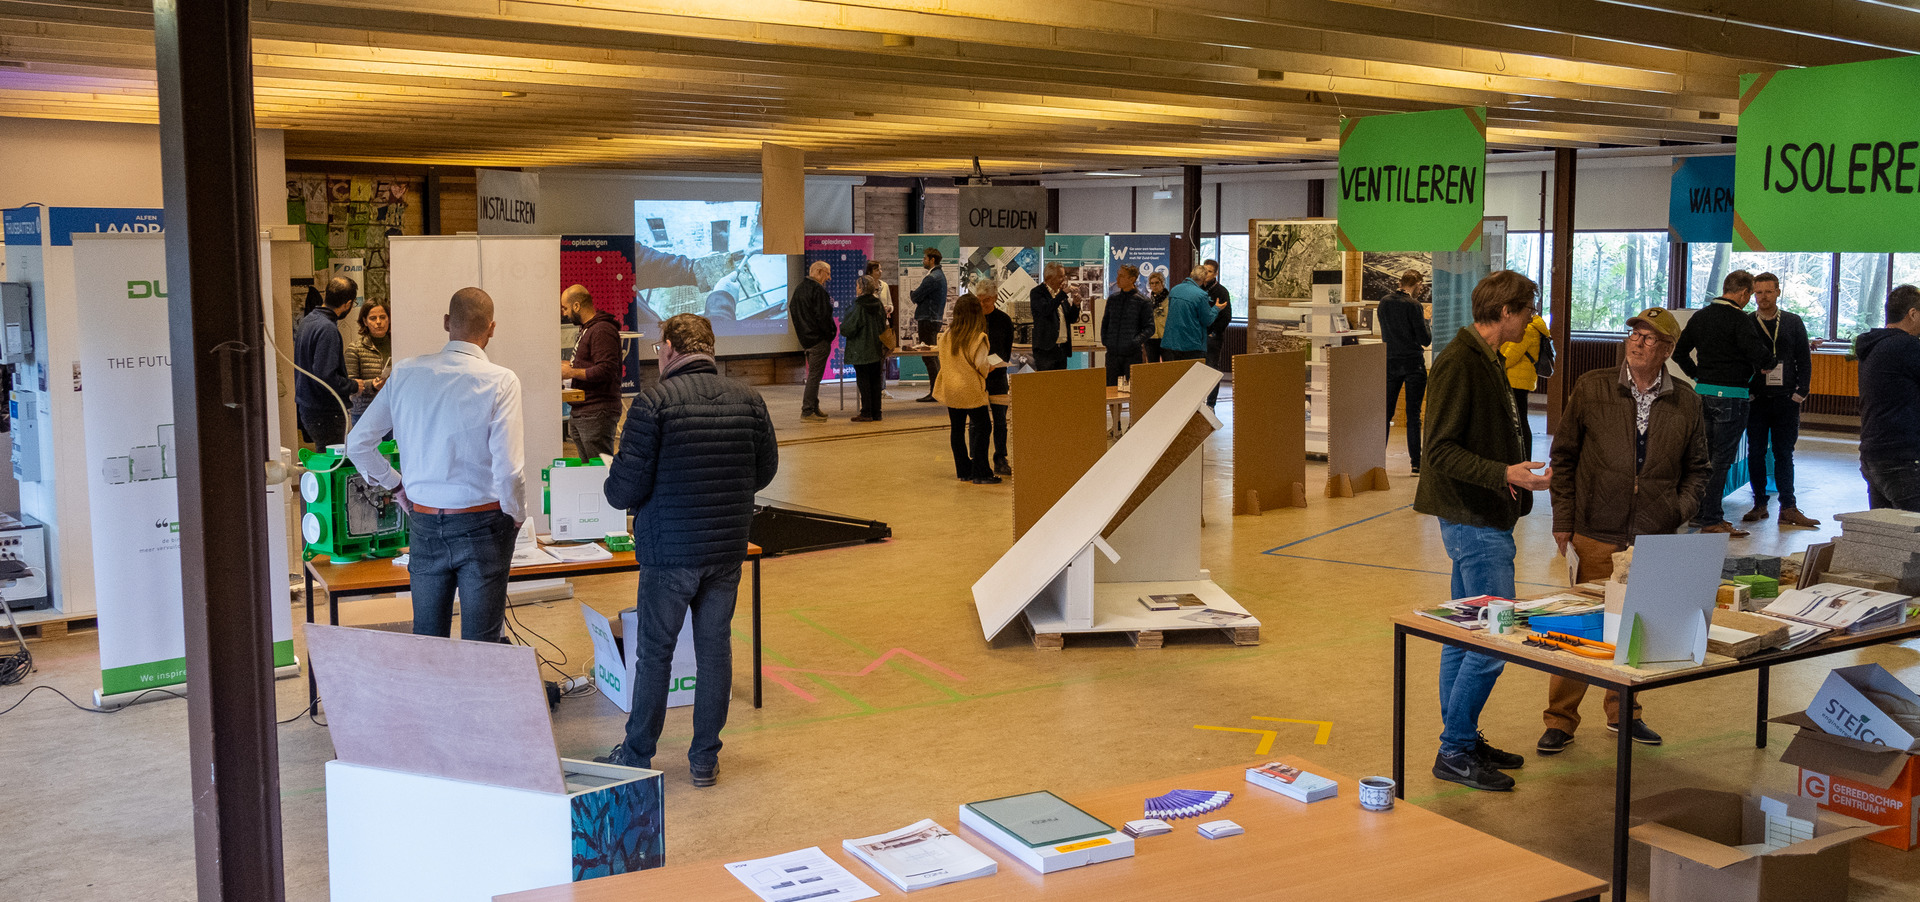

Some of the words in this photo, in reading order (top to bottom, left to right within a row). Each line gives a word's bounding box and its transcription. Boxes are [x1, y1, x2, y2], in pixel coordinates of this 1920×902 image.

[1763, 141, 1920, 194] ISOLERE
[1340, 164, 1477, 204] VENTILEREN
[480, 196, 536, 225] INSTALLEREN
[1689, 186, 1734, 214] WARM
[95, 223, 164, 233] LAADP
[969, 208, 1037, 229] OPLEIDEN
[107, 357, 134, 369] THE
[140, 674, 154, 682] We
[599, 664, 620, 692] DUCO
[1832, 784, 1903, 810] GEREEDSCHAP
[1832, 794, 1879, 815] CENTRUM
